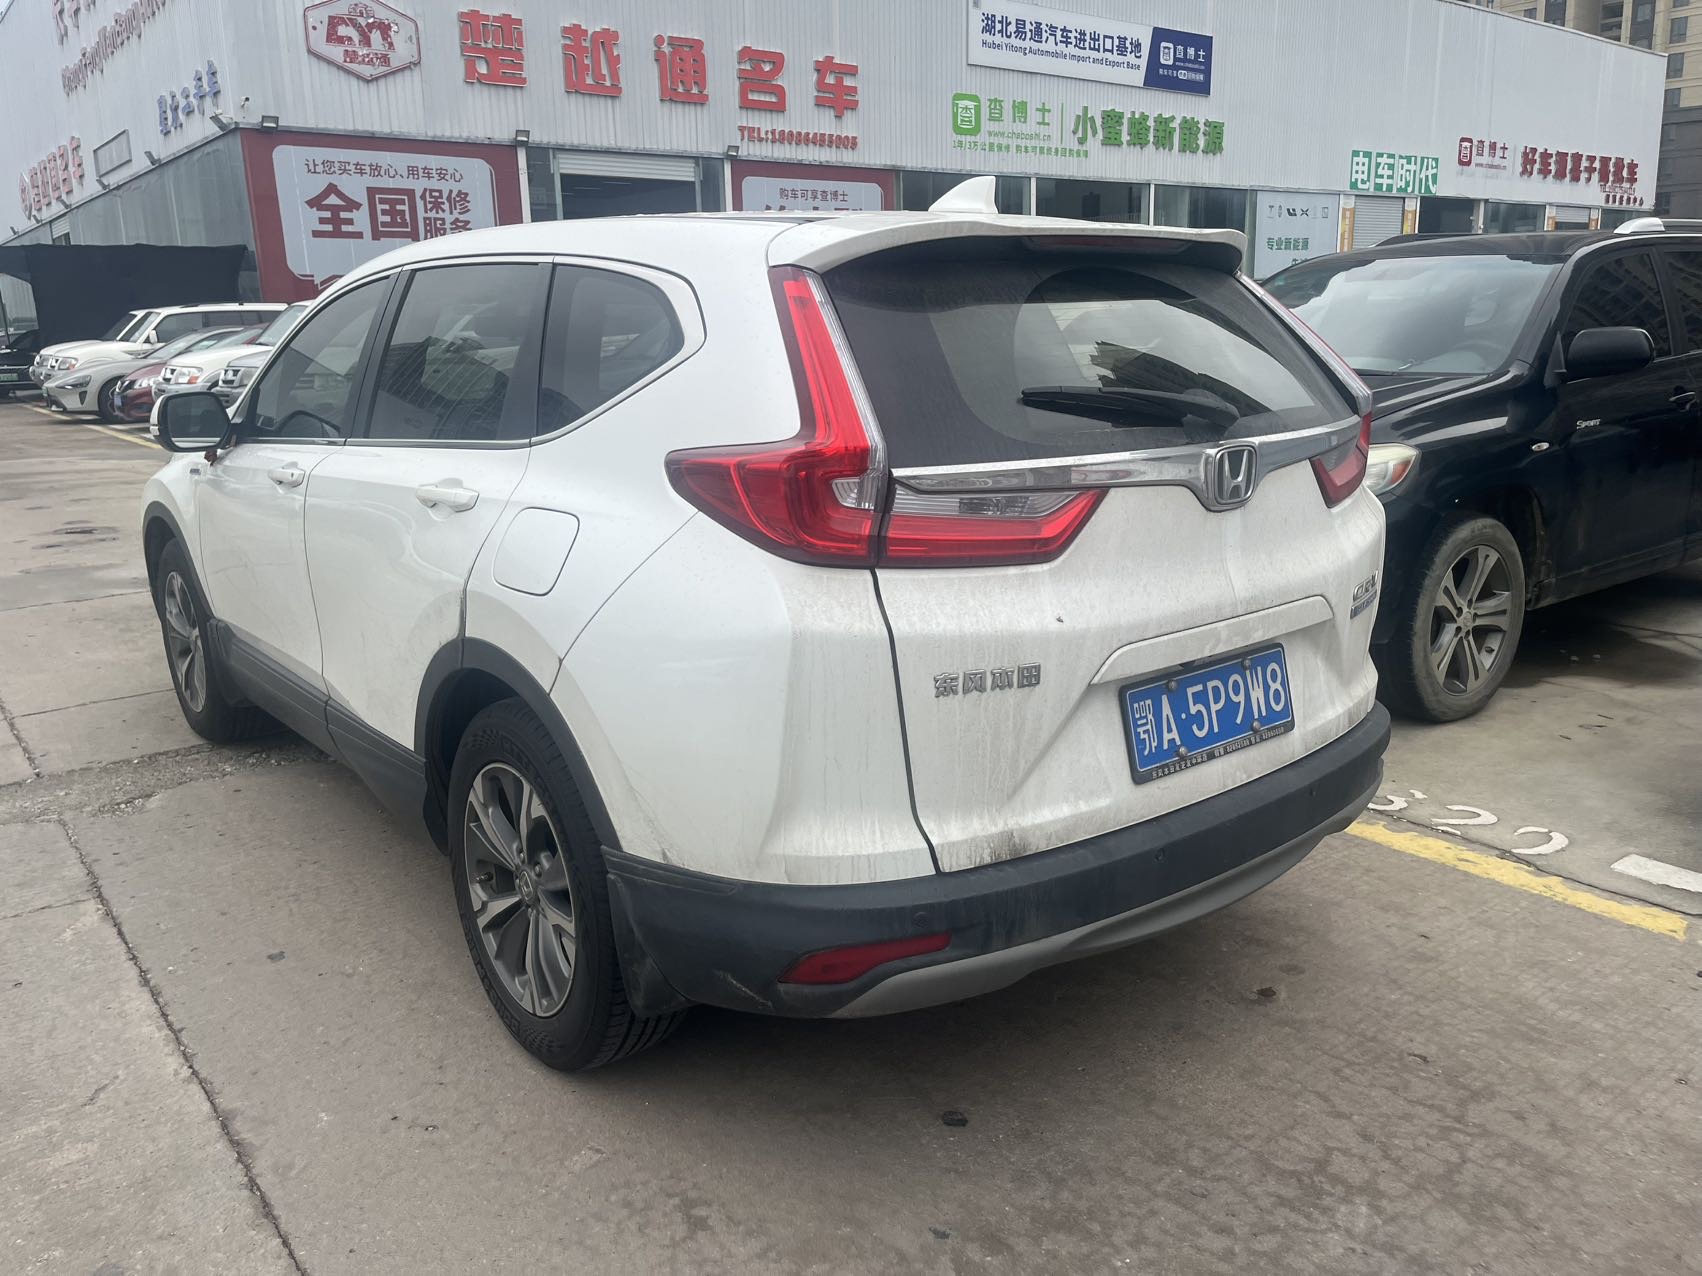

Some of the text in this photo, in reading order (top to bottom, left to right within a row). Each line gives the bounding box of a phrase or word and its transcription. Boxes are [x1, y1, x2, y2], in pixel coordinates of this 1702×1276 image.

[981, 12, 1142, 59] 湖北易通汽车进出口基地
[458, 9, 861, 117] 楚越通名车
[981, 39, 1141, 71] Hubei Yitong Automobile Import and Export Base
[987, 97, 1052, 127] 查博士
[1072, 105, 1225, 156] 小蜜蜂新能源
[1475, 139, 1509, 160] 查博士
[304, 158, 464, 183] 让您买车放心、用车安心
[1351, 151, 1437, 193] 电车时代
[304, 182, 421, 242] 全国
[420, 187, 471, 216] 保修
[778, 187, 849, 203] 购车可享查博士
[1266, 237, 1310, 251] 专业新能源
[933, 662, 1041, 698] 东风本田
[1133, 661, 1286, 756] 鄂A·5P9W8
